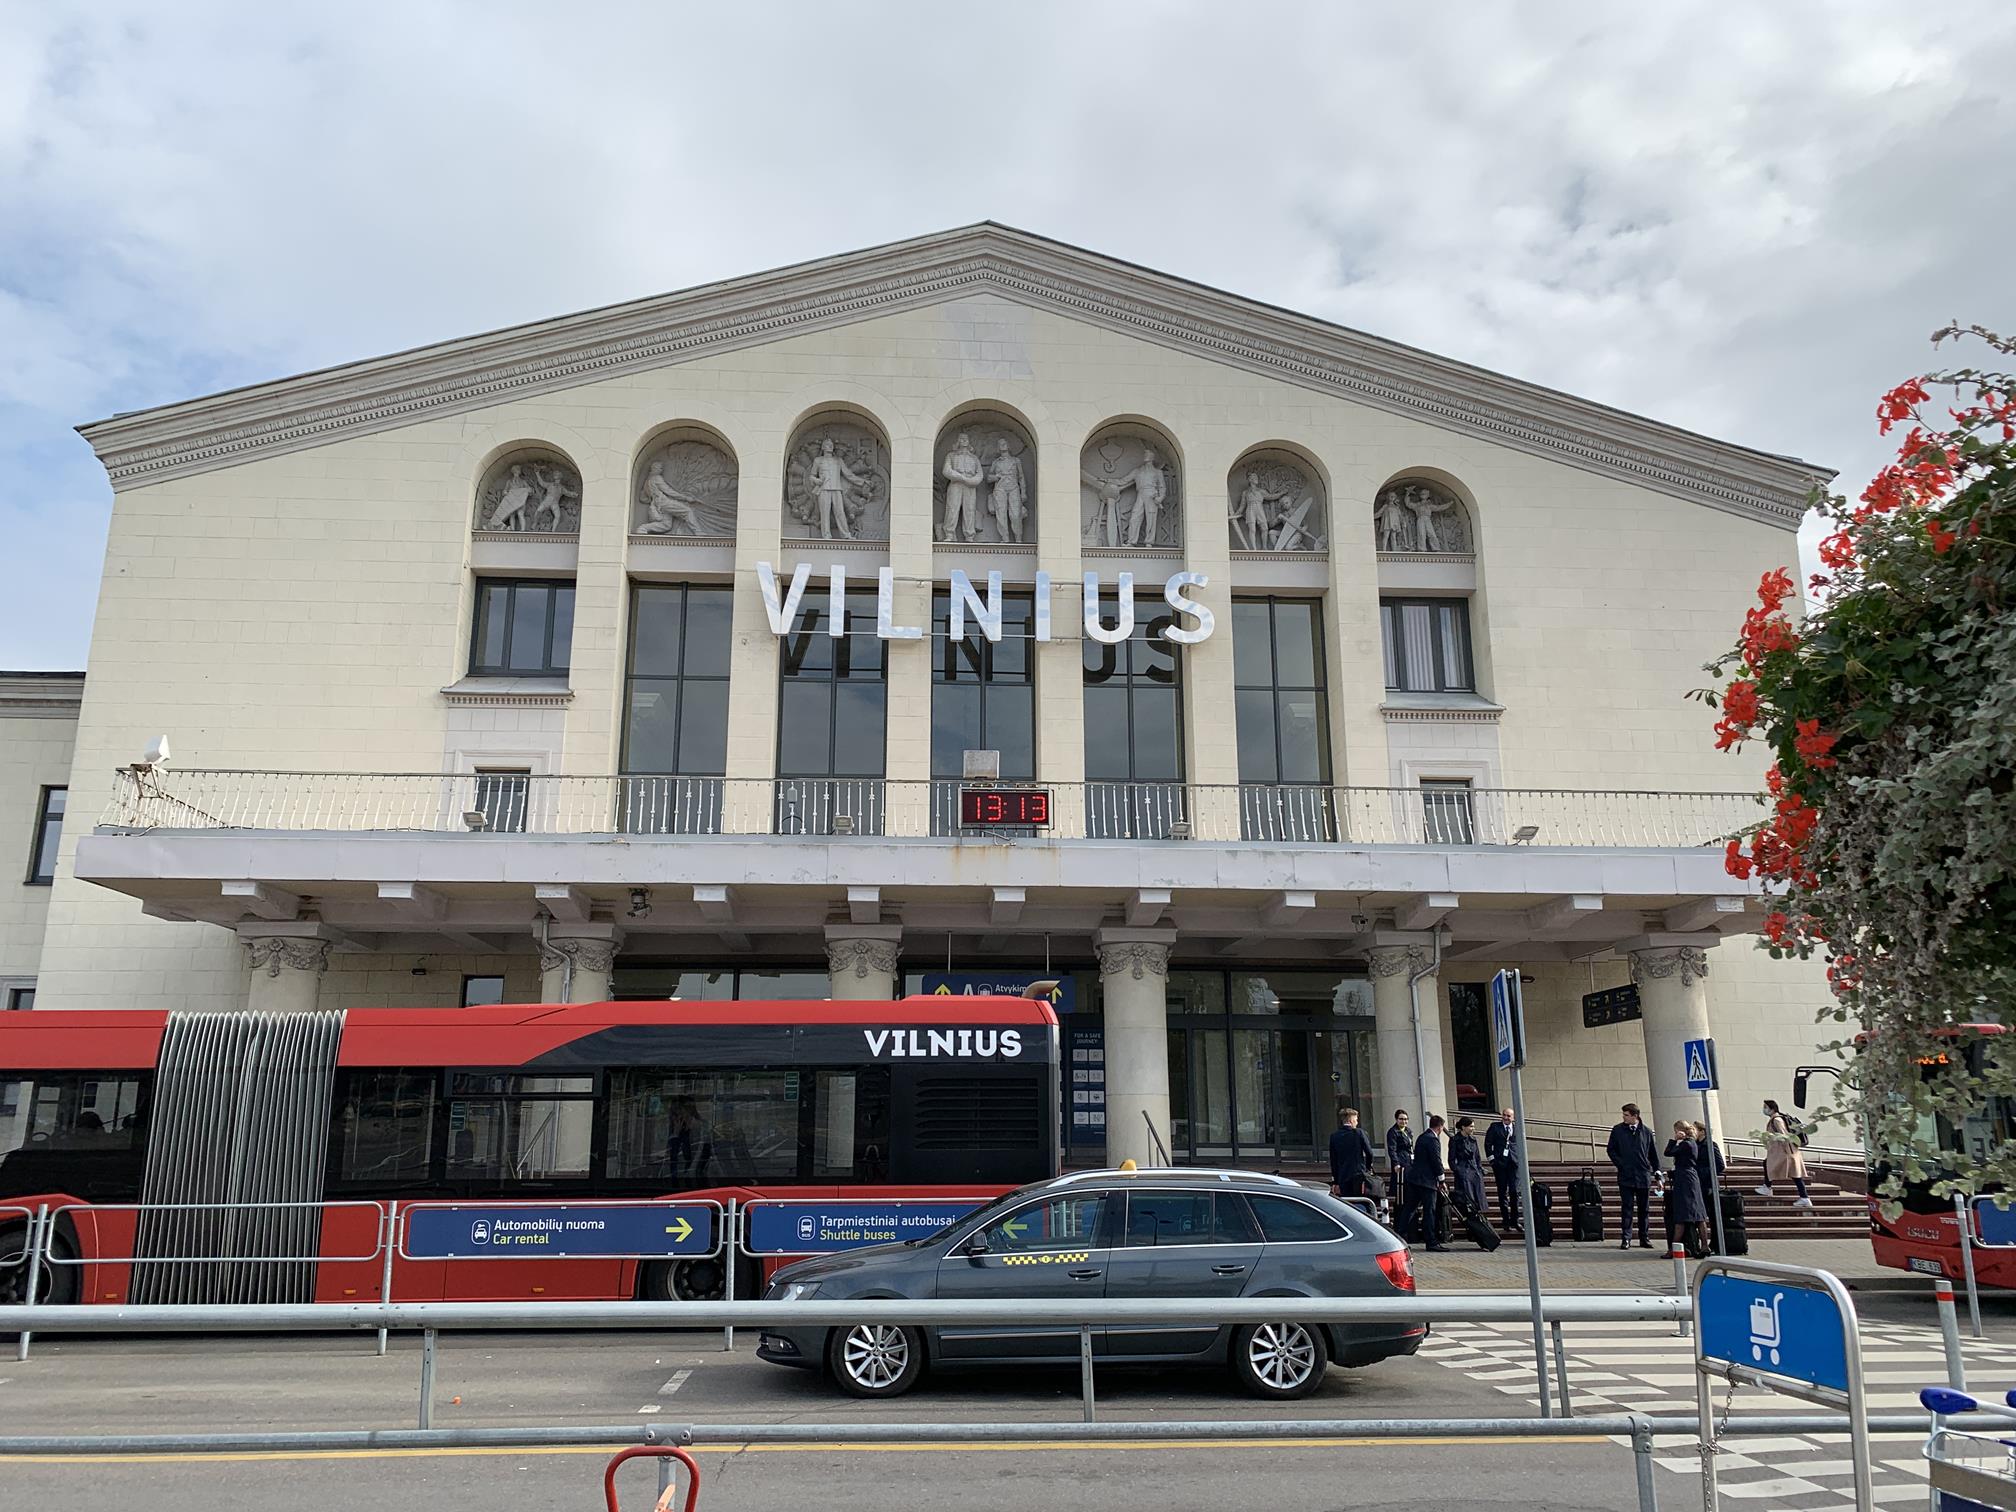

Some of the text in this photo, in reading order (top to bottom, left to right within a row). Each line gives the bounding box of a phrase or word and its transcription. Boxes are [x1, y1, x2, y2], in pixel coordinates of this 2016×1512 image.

[755, 561, 1215, 645] VILNIUS
[977, 795, 1046, 821] 13:13
[995, 984, 1027, 994] Atvykim
[864, 1029, 1022, 1057] VILNIUS
[494, 1219, 605, 1233] Automobilių nuoma
[820, 1214, 956, 1229] Tarpmiestiniai autobusai
[493, 1233, 549, 1245] Car rental
[820, 1229, 896, 1241] Shuttle buses
